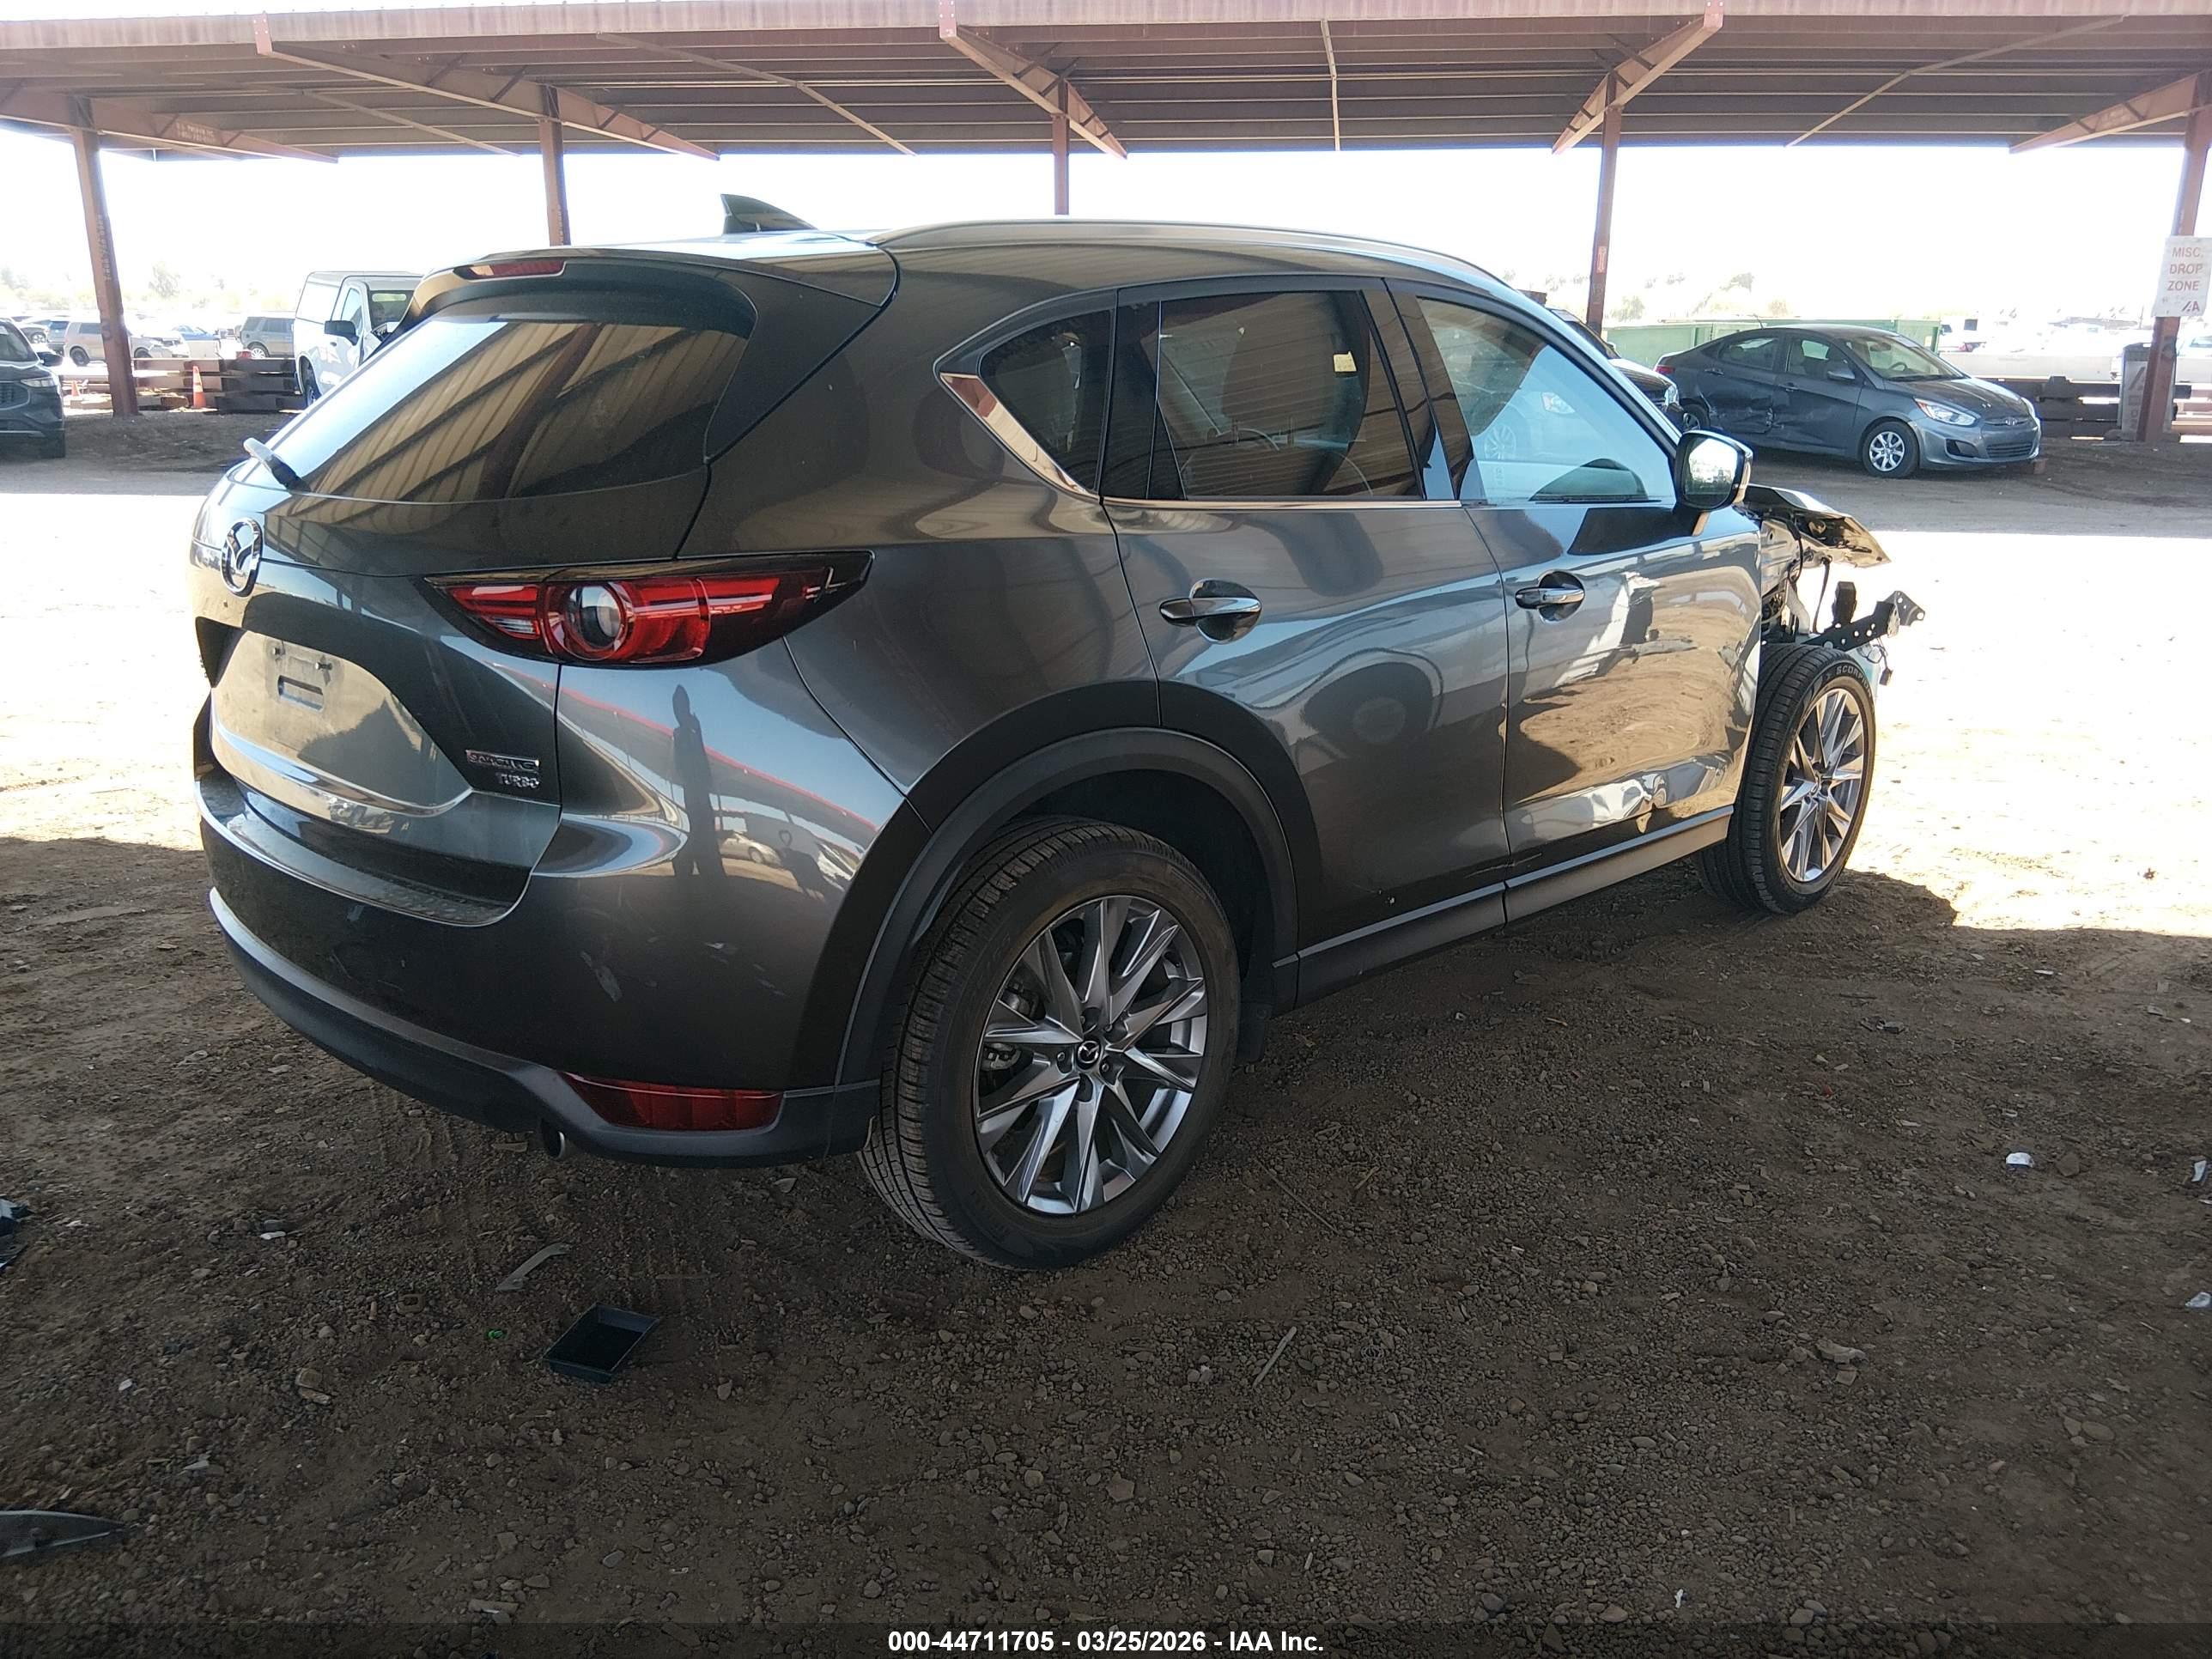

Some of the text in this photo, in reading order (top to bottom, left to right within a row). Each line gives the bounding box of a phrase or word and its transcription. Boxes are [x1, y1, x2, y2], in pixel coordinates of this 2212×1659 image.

[2171, 247, 2204, 258] MISC.
[2169, 264, 2203, 275] DROP
[2166, 281, 2200, 291] ZONE
[497, 773, 540, 788] TURBO
